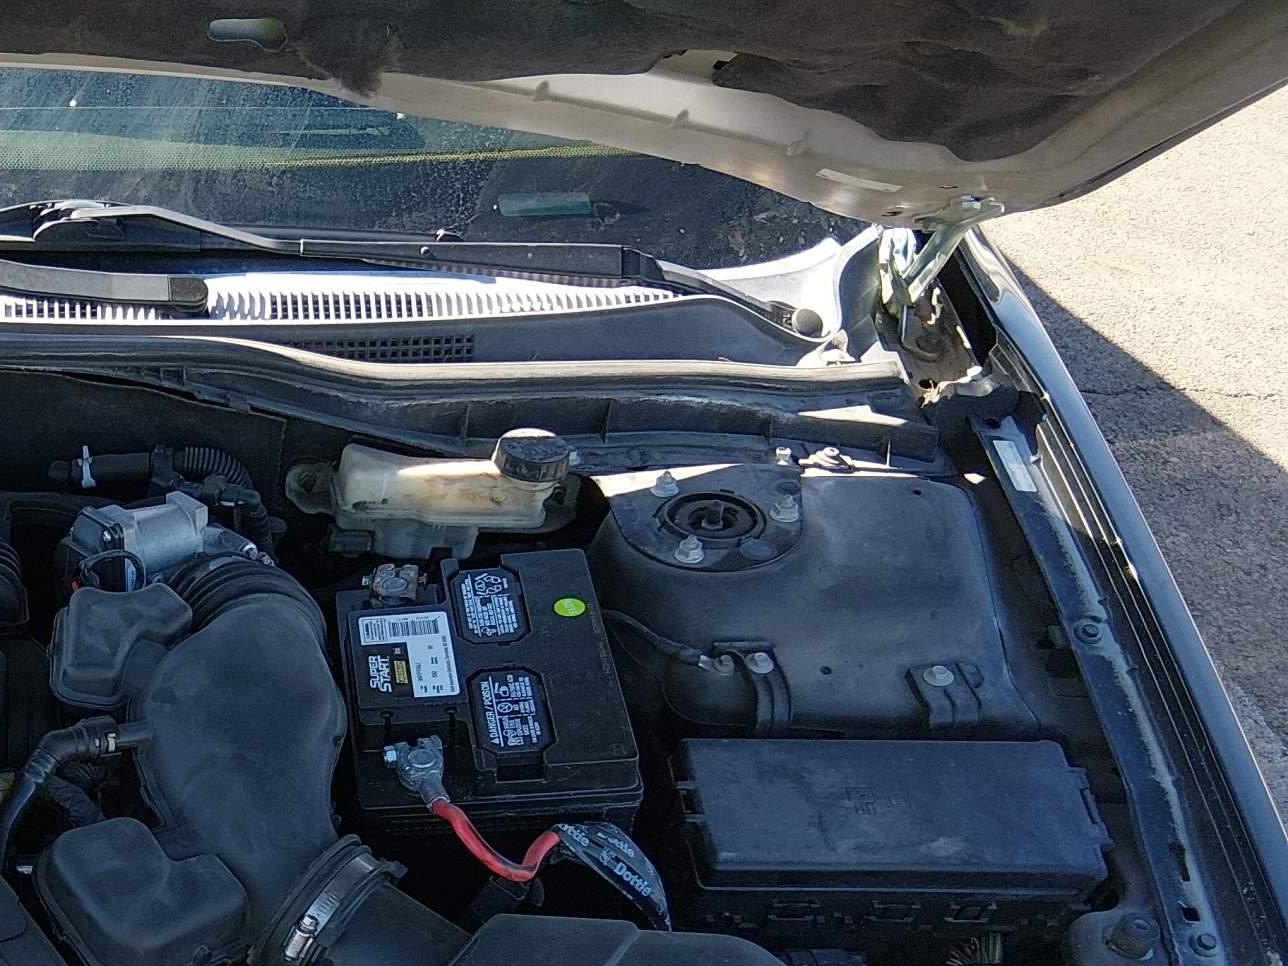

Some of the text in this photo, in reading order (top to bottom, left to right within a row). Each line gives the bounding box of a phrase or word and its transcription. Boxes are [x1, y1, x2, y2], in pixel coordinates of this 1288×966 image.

[368, 655, 382, 689] SUPER
[377, 655, 392, 693] START
[480, 681, 493, 705] POISON
[485, 711, 499, 738] DANGER
[613, 862, 652, 897] Dottie
